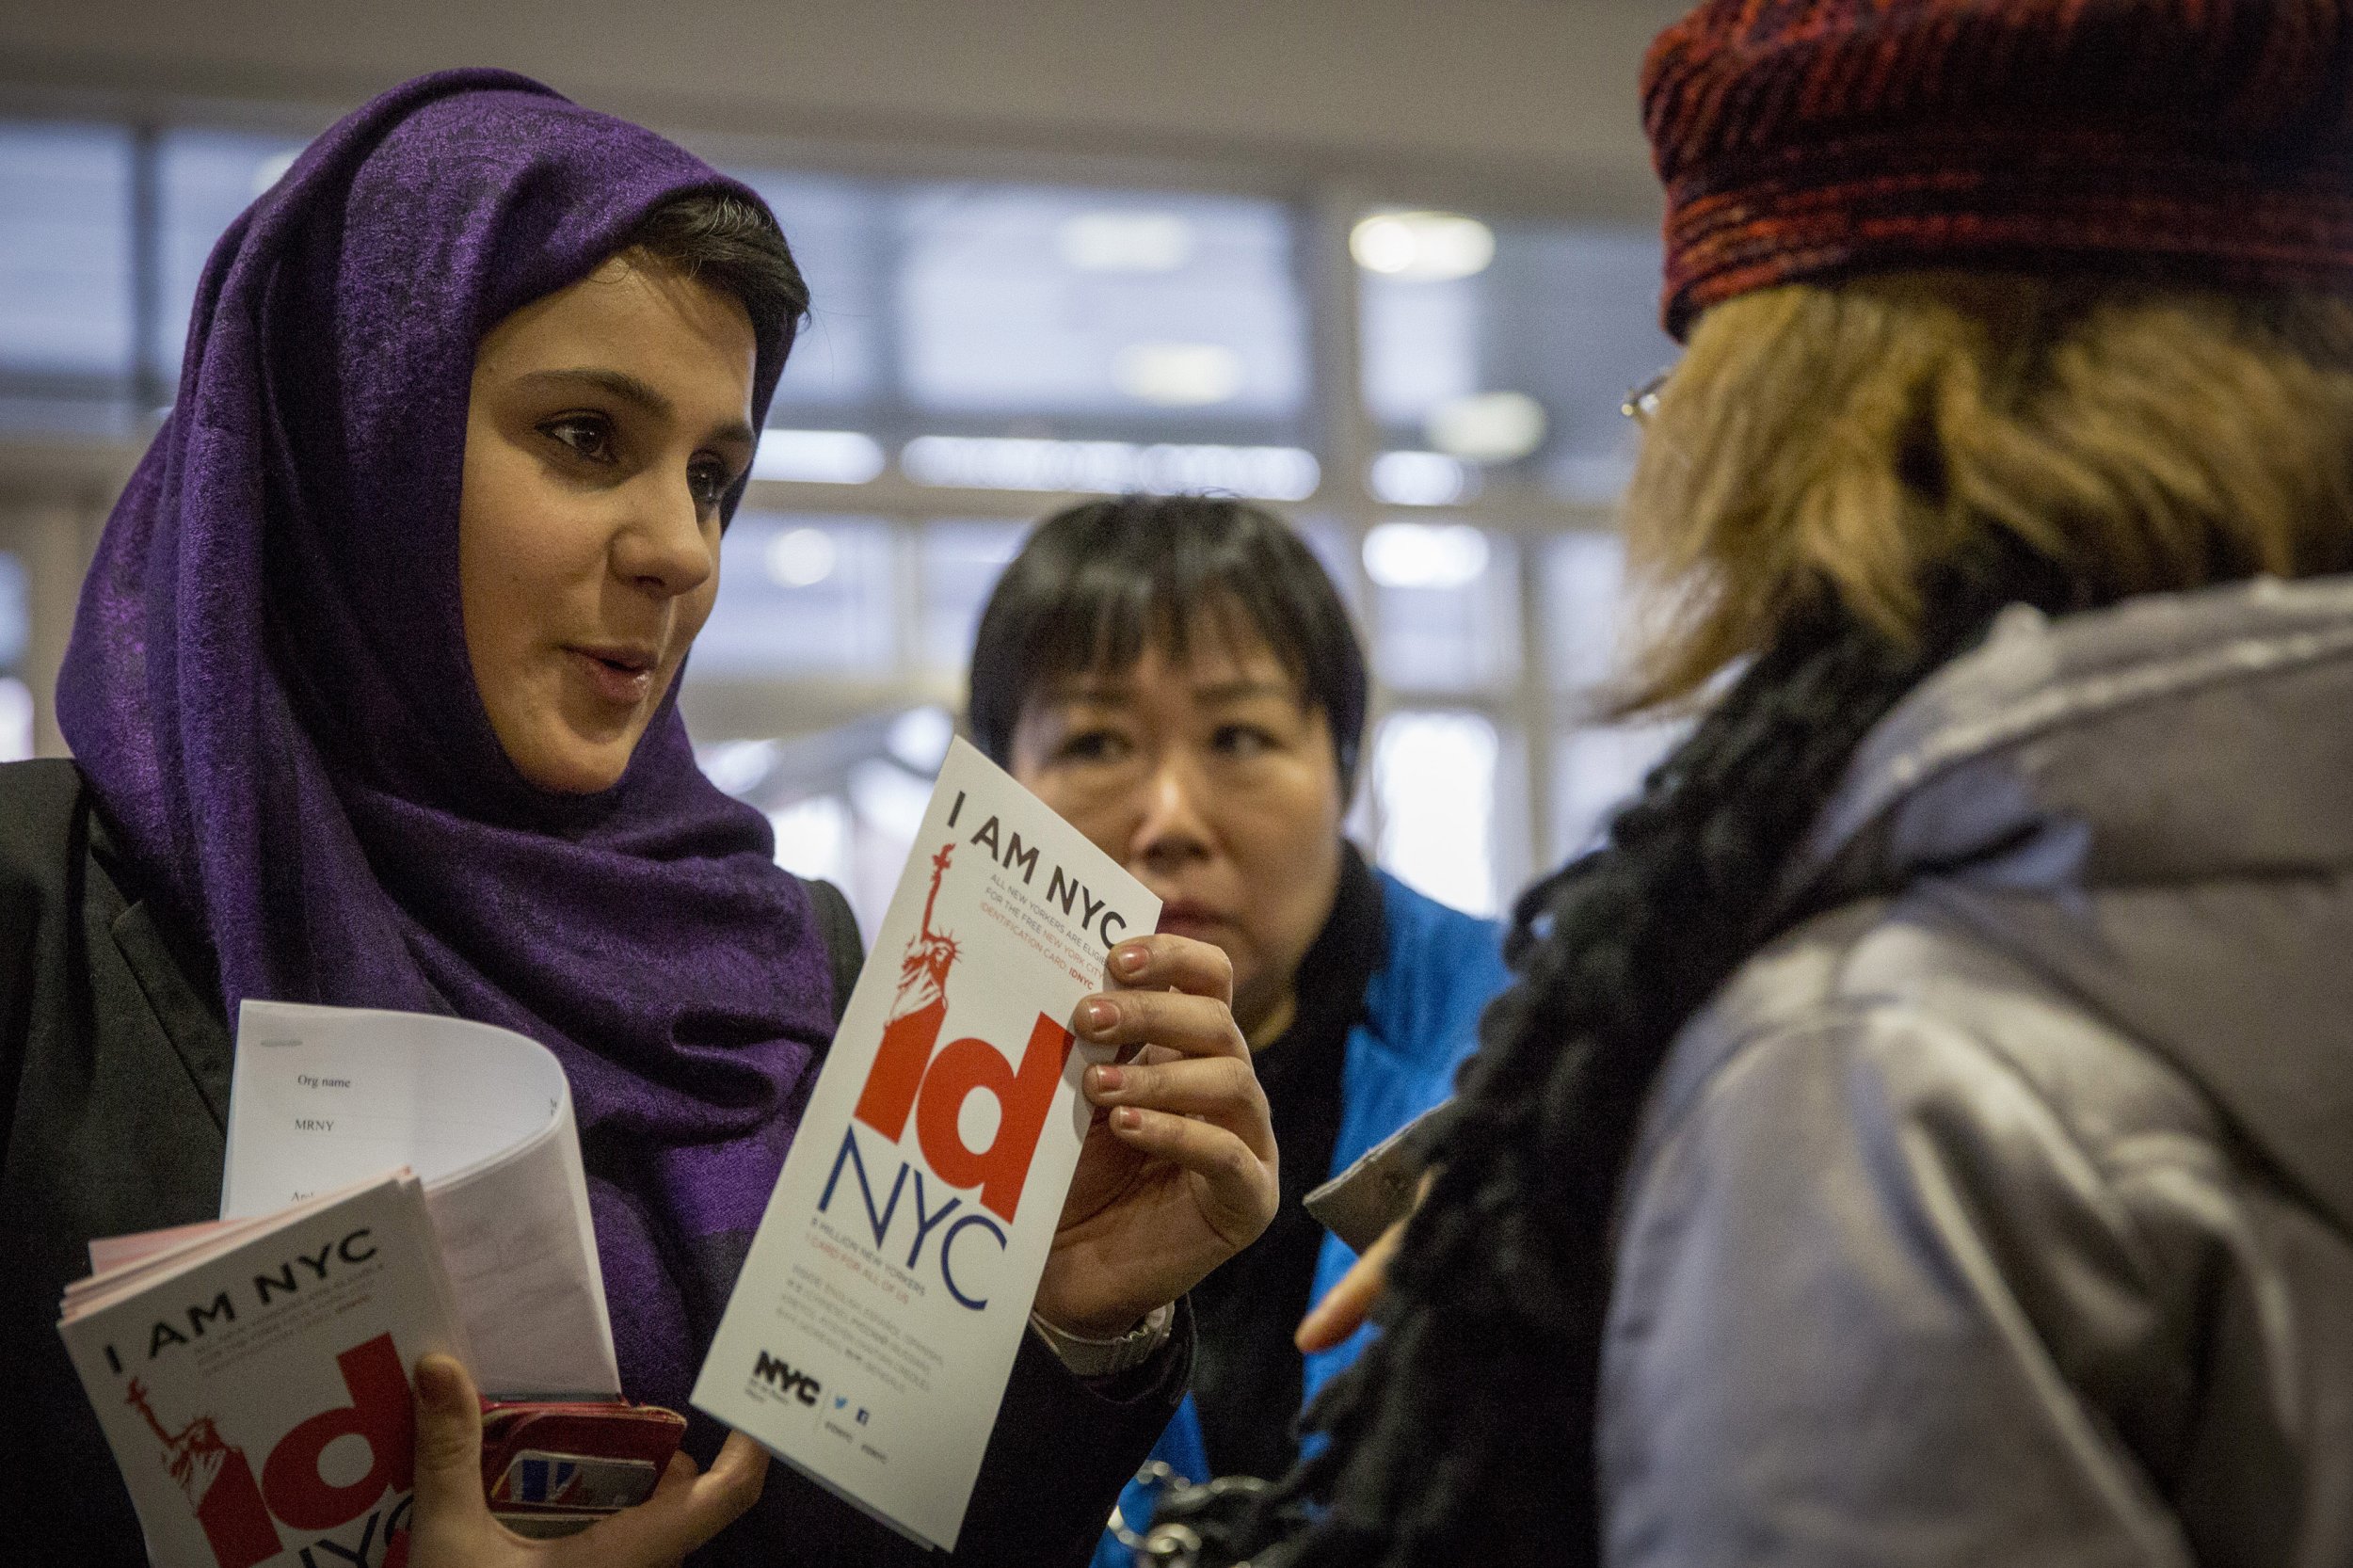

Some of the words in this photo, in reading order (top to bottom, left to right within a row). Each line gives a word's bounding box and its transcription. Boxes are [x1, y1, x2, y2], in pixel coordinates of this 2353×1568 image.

[947, 791, 966, 828] I
[970, 816, 1040, 886] AM
[1046, 864, 1127, 951] NYC
[980, 901, 1043, 953] IDENTIFICATION
[1069, 967, 1095, 990] IDNYC
[986, 887, 1003, 904] FOR
[1005, 900, 1020, 919] THE
[1021, 912, 1042, 935] FREE
[1044, 930, 1063, 949] NEW
[1064, 946, 1085, 967] YORK
[1086, 963, 1104, 980] CITY
[991, 874, 1005, 890] ALL
[1008, 886, 1028, 904] NEW
[1030, 902, 1065, 934] YORKERS
[1065, 931, 1082, 948] ARE
[1082, 942, 1108, 967] ELIGIB
[295, 1119, 334, 1131] MRNY
[297, 1074, 319, 1089] Org
[322, 1078, 351, 1089] name
[817, 1123, 1008, 1311] NYC
[104, 1343, 122, 1374] I
[149, 1291, 235, 1360] AM
[254, 1228, 376, 1305] NYC
[753, 1350, 821, 1407] NYC
